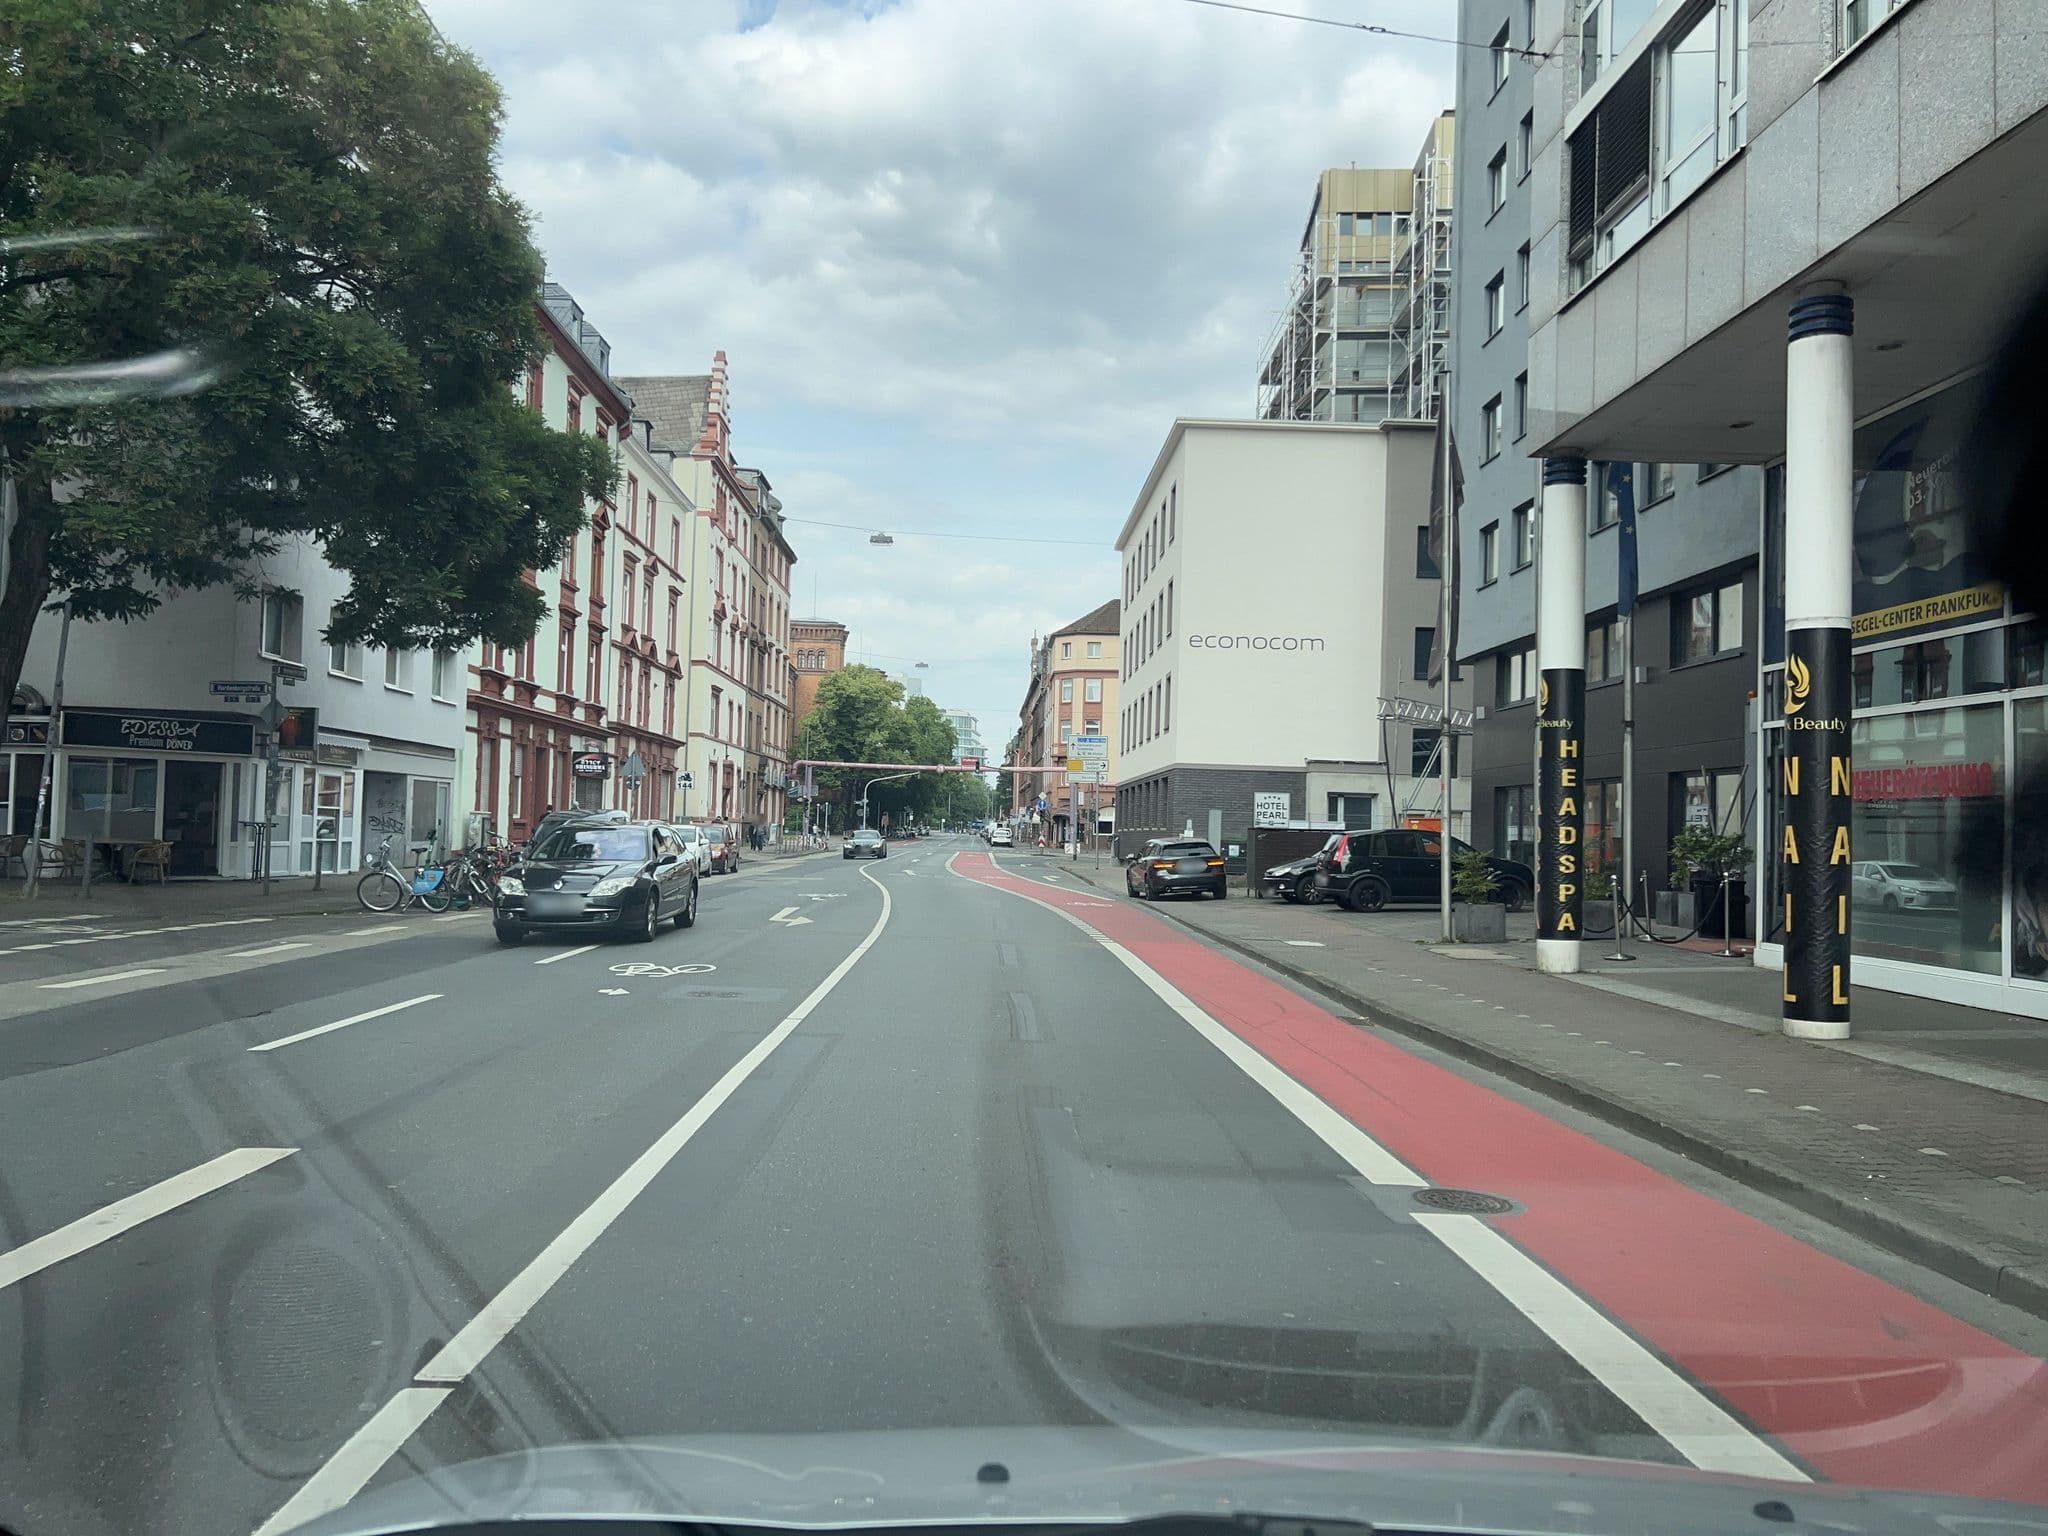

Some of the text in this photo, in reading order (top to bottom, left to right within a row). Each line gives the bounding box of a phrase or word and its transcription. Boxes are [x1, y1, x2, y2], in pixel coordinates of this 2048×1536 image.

[1851, 605, 1922, 634] SEGEL-CENTER
[1189, 634, 1325, 651] econocom
[121, 719, 200, 737] EDESSA
[1540, 718, 1574, 729] Beauty
[1794, 717, 1847, 734] Beauty
[1256, 802, 1287, 810] HOTEL
[1256, 811, 1287, 819] PEARL
[1830, 757, 1850, 1004] NAIL
